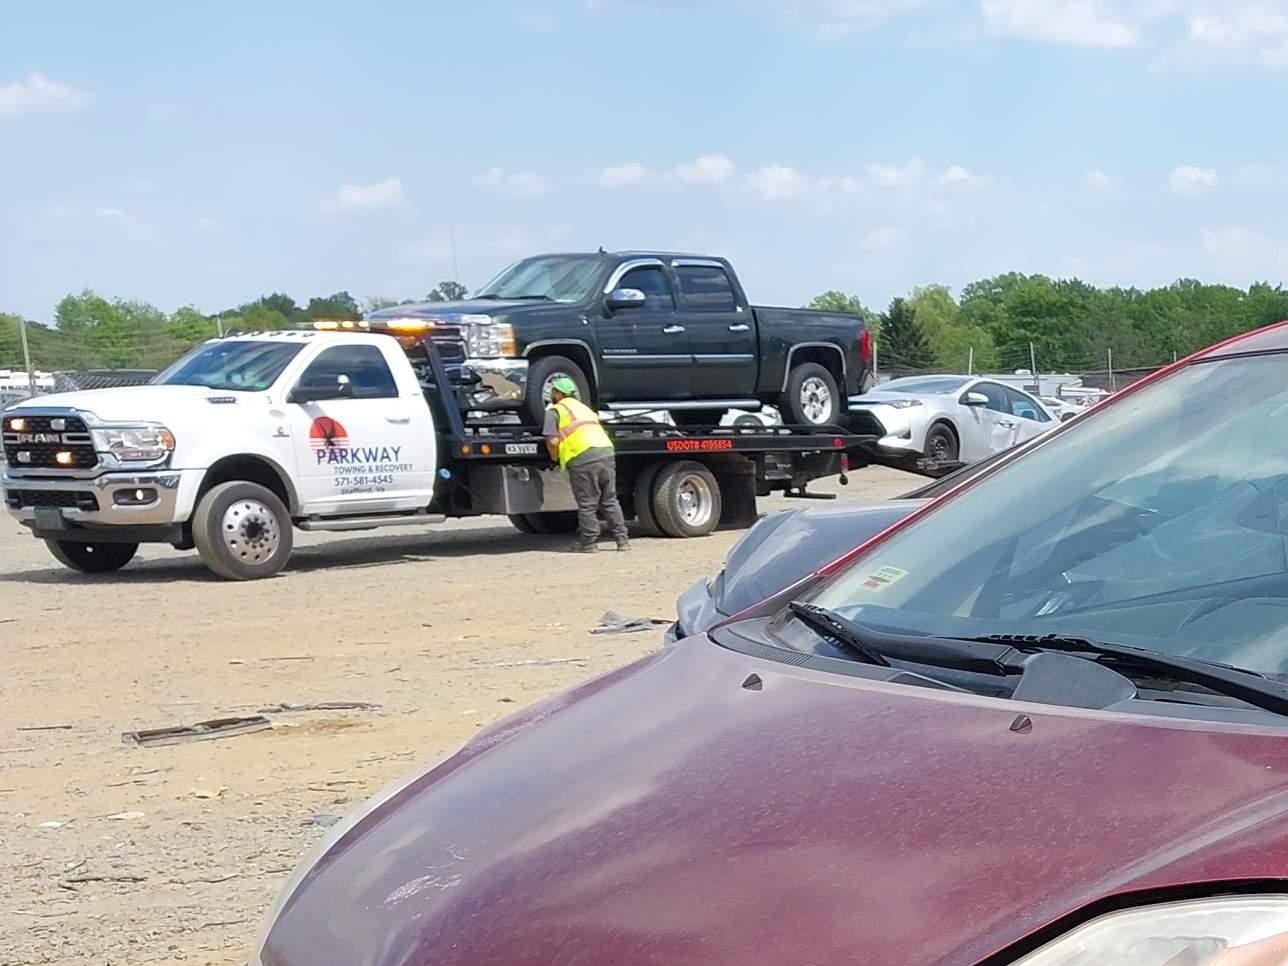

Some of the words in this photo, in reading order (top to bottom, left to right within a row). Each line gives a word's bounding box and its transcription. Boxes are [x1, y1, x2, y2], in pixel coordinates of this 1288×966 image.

[20, 433, 60, 443] RAM
[666, 440, 700, 450] USDOT#
[316, 446, 402, 465] PARKWAY
[334, 465, 367, 475] TOWING
[375, 463, 413, 473] RECOVERY
[334, 474, 394, 486] 571-581-4545
